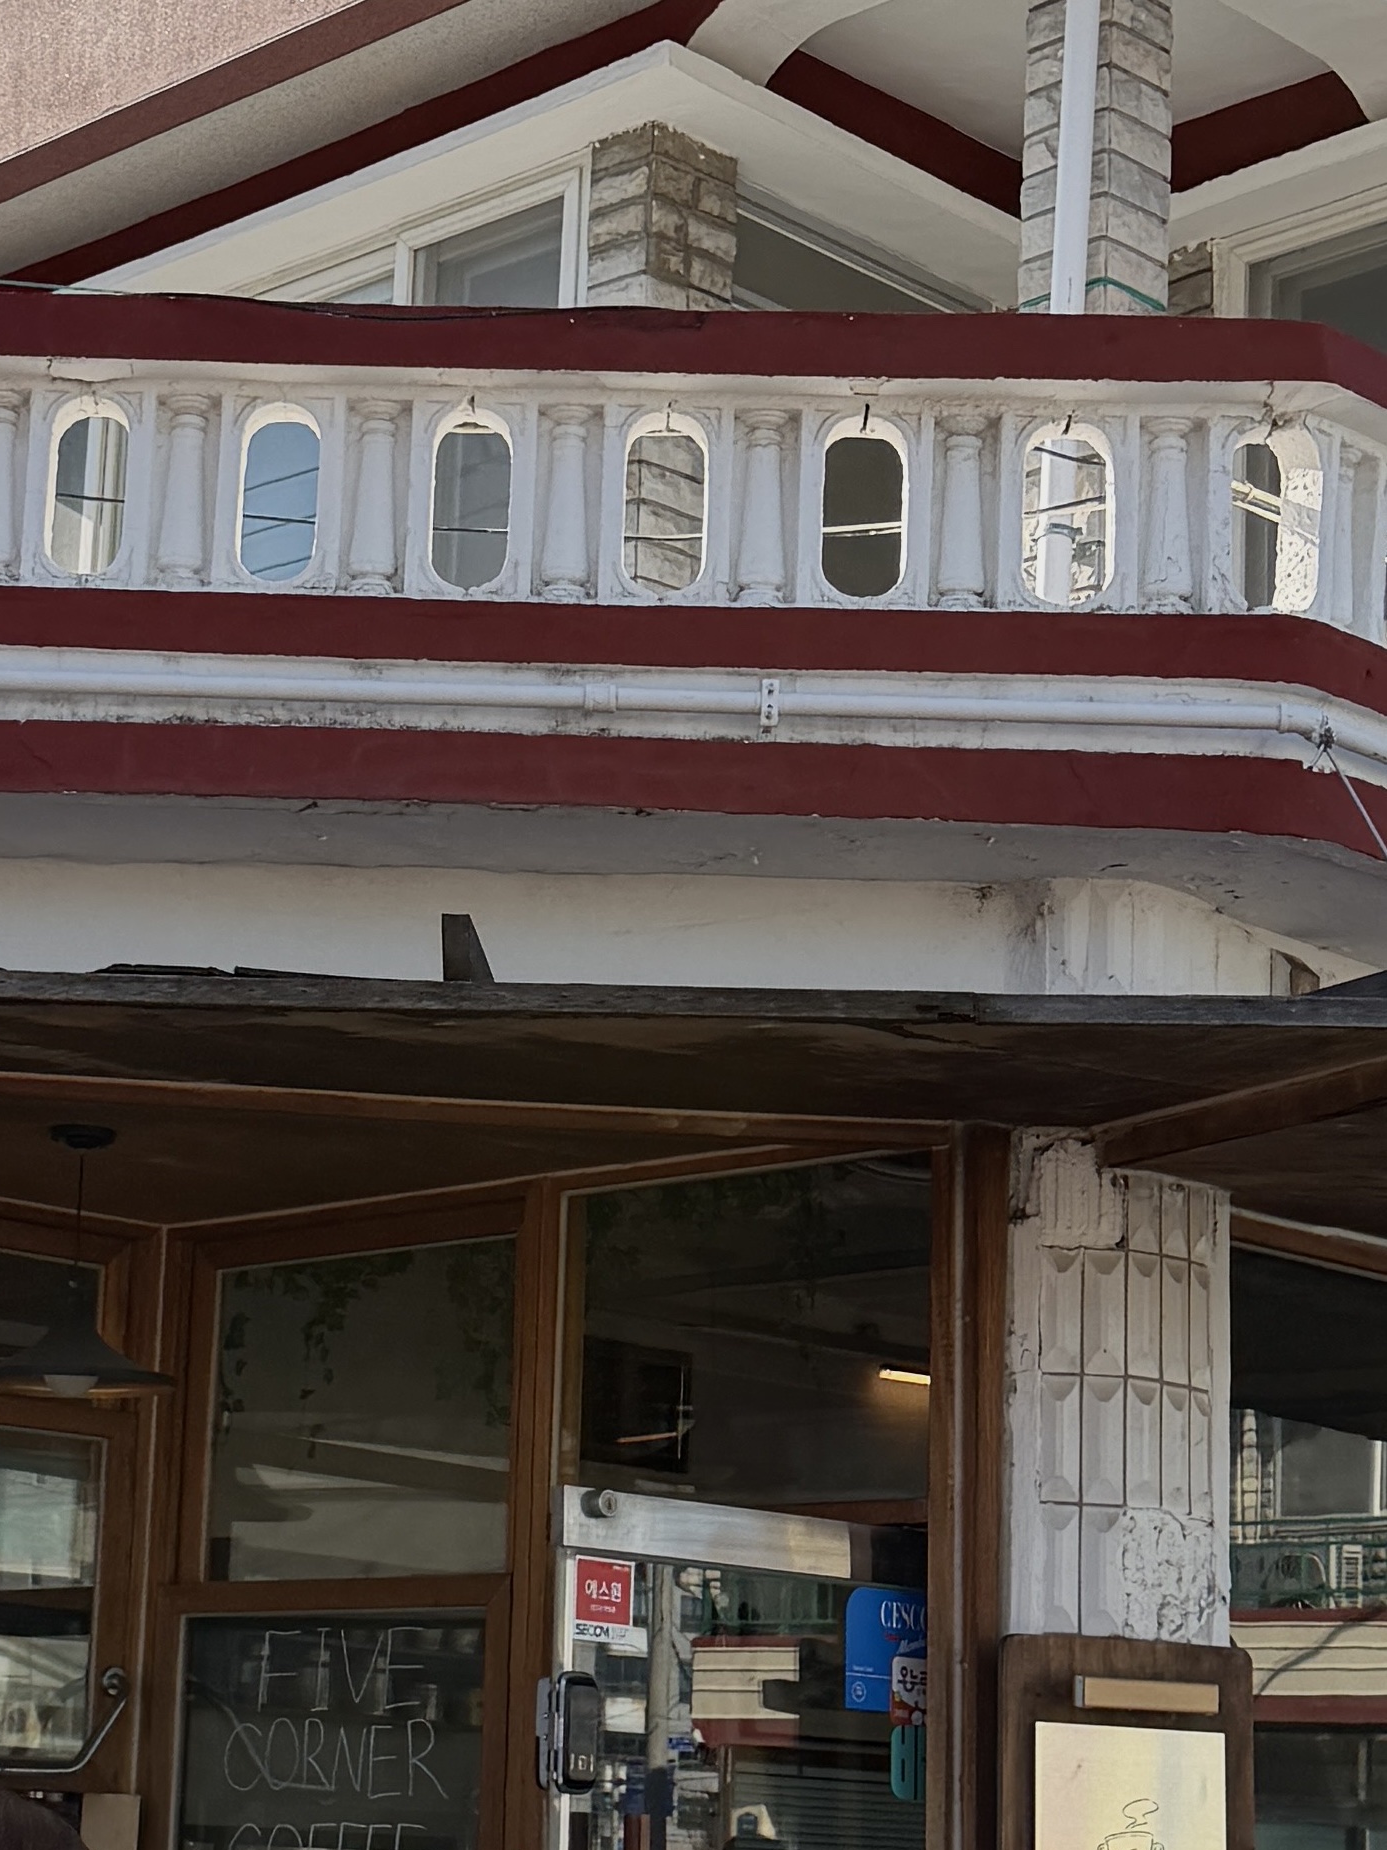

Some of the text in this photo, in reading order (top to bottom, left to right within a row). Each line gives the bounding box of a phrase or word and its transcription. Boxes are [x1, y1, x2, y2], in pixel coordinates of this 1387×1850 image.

[585, 1578, 622, 1602] 에스원
[258, 1626, 425, 1715] FIVE
[224, 1717, 449, 1799] CORNER
